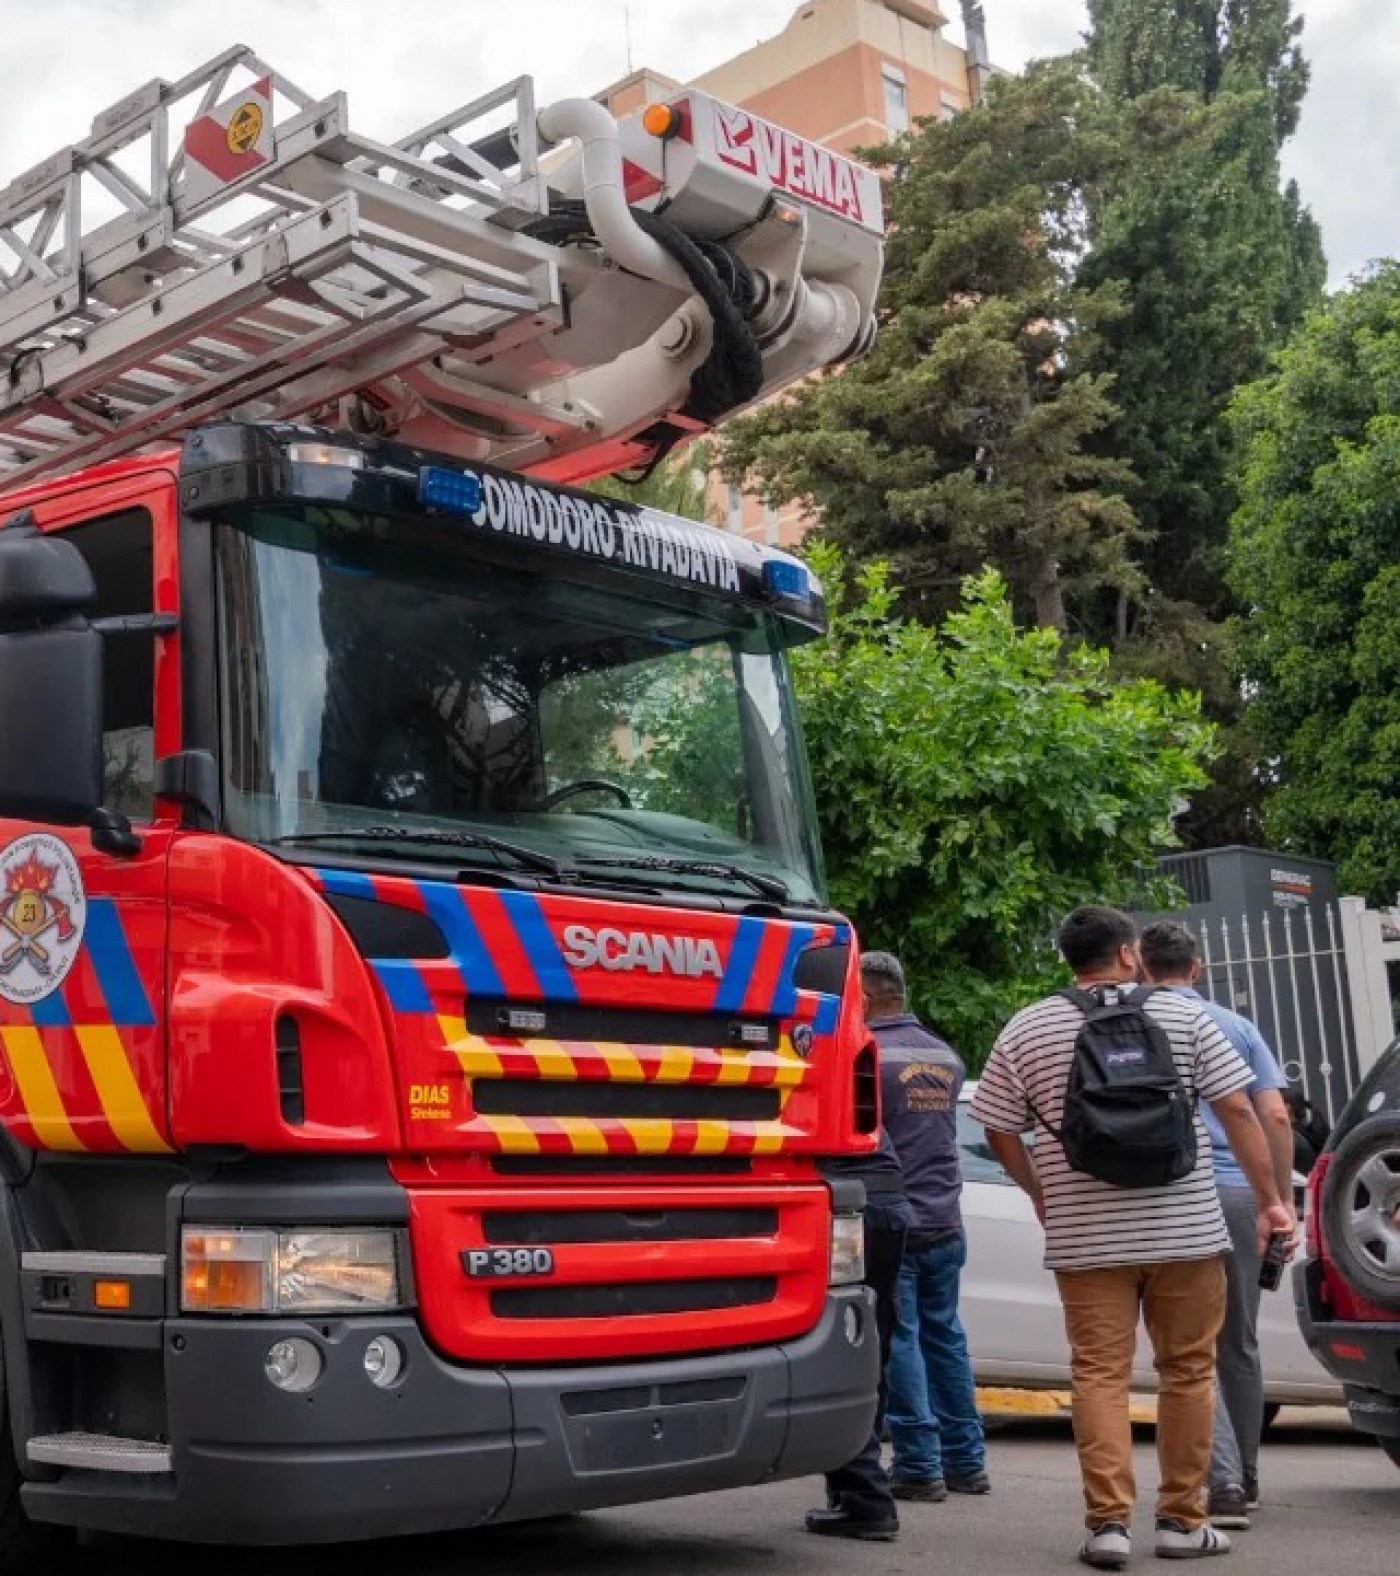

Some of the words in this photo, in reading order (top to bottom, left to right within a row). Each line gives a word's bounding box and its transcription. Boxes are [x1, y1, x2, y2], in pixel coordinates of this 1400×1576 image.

[758, 119, 864, 222] VEMA
[563, 925, 724, 978] SCANIA
[409, 1085, 449, 1104] DIAS
[469, 1251, 489, 1275] P
[493, 1249, 552, 1274] 380
